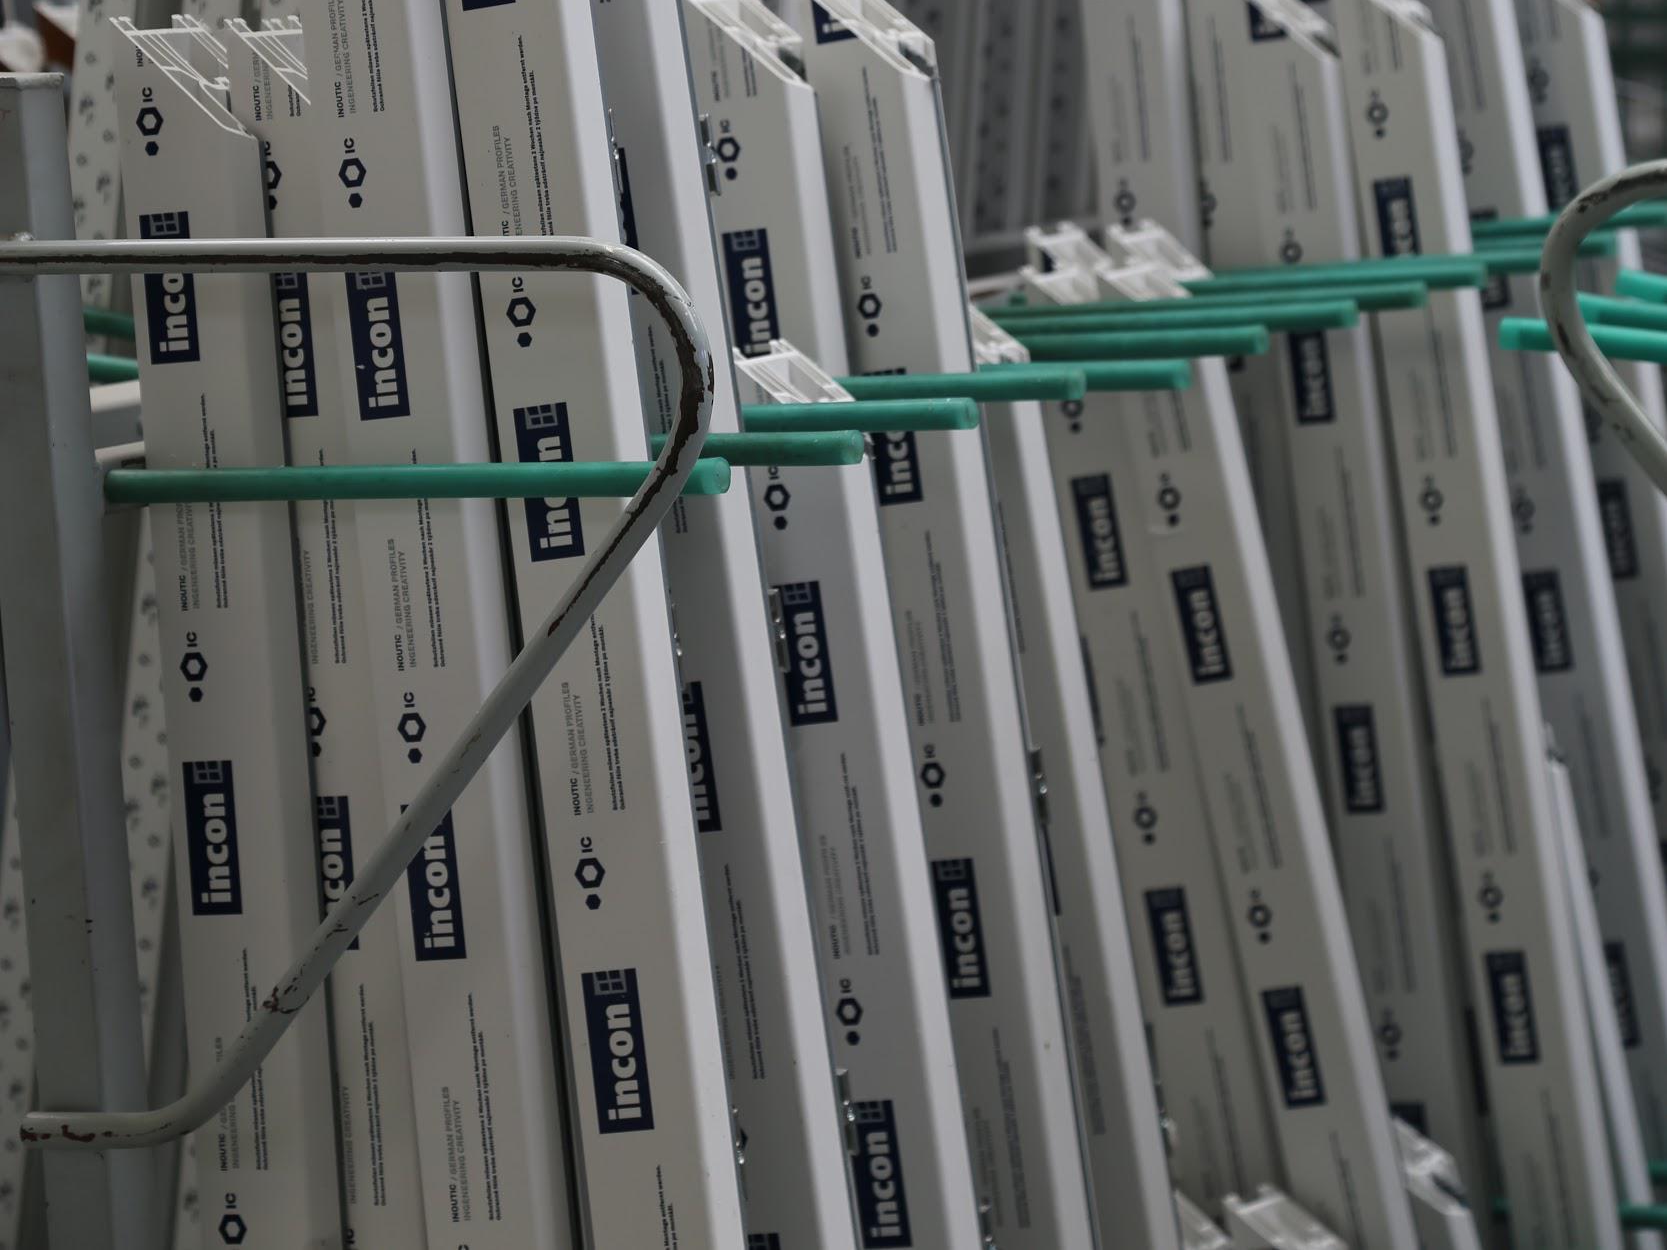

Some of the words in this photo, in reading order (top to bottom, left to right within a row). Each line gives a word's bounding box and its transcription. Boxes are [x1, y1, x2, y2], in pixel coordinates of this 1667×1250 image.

[332, 33, 342, 71] GERMAN
[142, 87, 153, 102] IC
[253, 85, 262, 121] INOUTIC
[334, 81, 344, 118] INOUTIC
[344, 137, 355, 153] IC
[492, 125, 504, 168] PROFILES
[504, 137, 516, 188] CREATIVITY
[498, 170, 509, 209] GERMAN
[510, 190, 522, 236] ENEERING
[512, 277, 524, 292] IC
[160, 273, 189, 353] inco
[744, 257, 772, 356] incon
[369, 297, 399, 408] incon
[768, 466, 779, 480] IC
[387, 538, 398, 582] PROFILES
[392, 585, 403, 624] GERMAN
[186, 631, 197, 647] IC
[394, 634, 405, 671] INOUTIC
[792, 611, 827, 714] incon
[404, 692, 415, 707] IC
[561, 682, 573, 727] PROFILES
[567, 729, 578, 768] GERMAN
[570, 778, 581, 816] INOUTIC
[202, 793, 232, 903] incon
[581, 836, 592, 852] IC
[424, 835, 456, 948] incon
[949, 888, 981, 988] incon
[605, 1003, 642, 1121] incon
[442, 1086, 452, 1132] PROFILES
[218, 1134, 228, 1171] INOUTIC
[446, 1134, 457, 1174] GERMAN
[225, 1193, 236, 1208] IC
[449, 1184, 459, 1222] INOUTIC
[866, 1131, 902, 1237] incon
